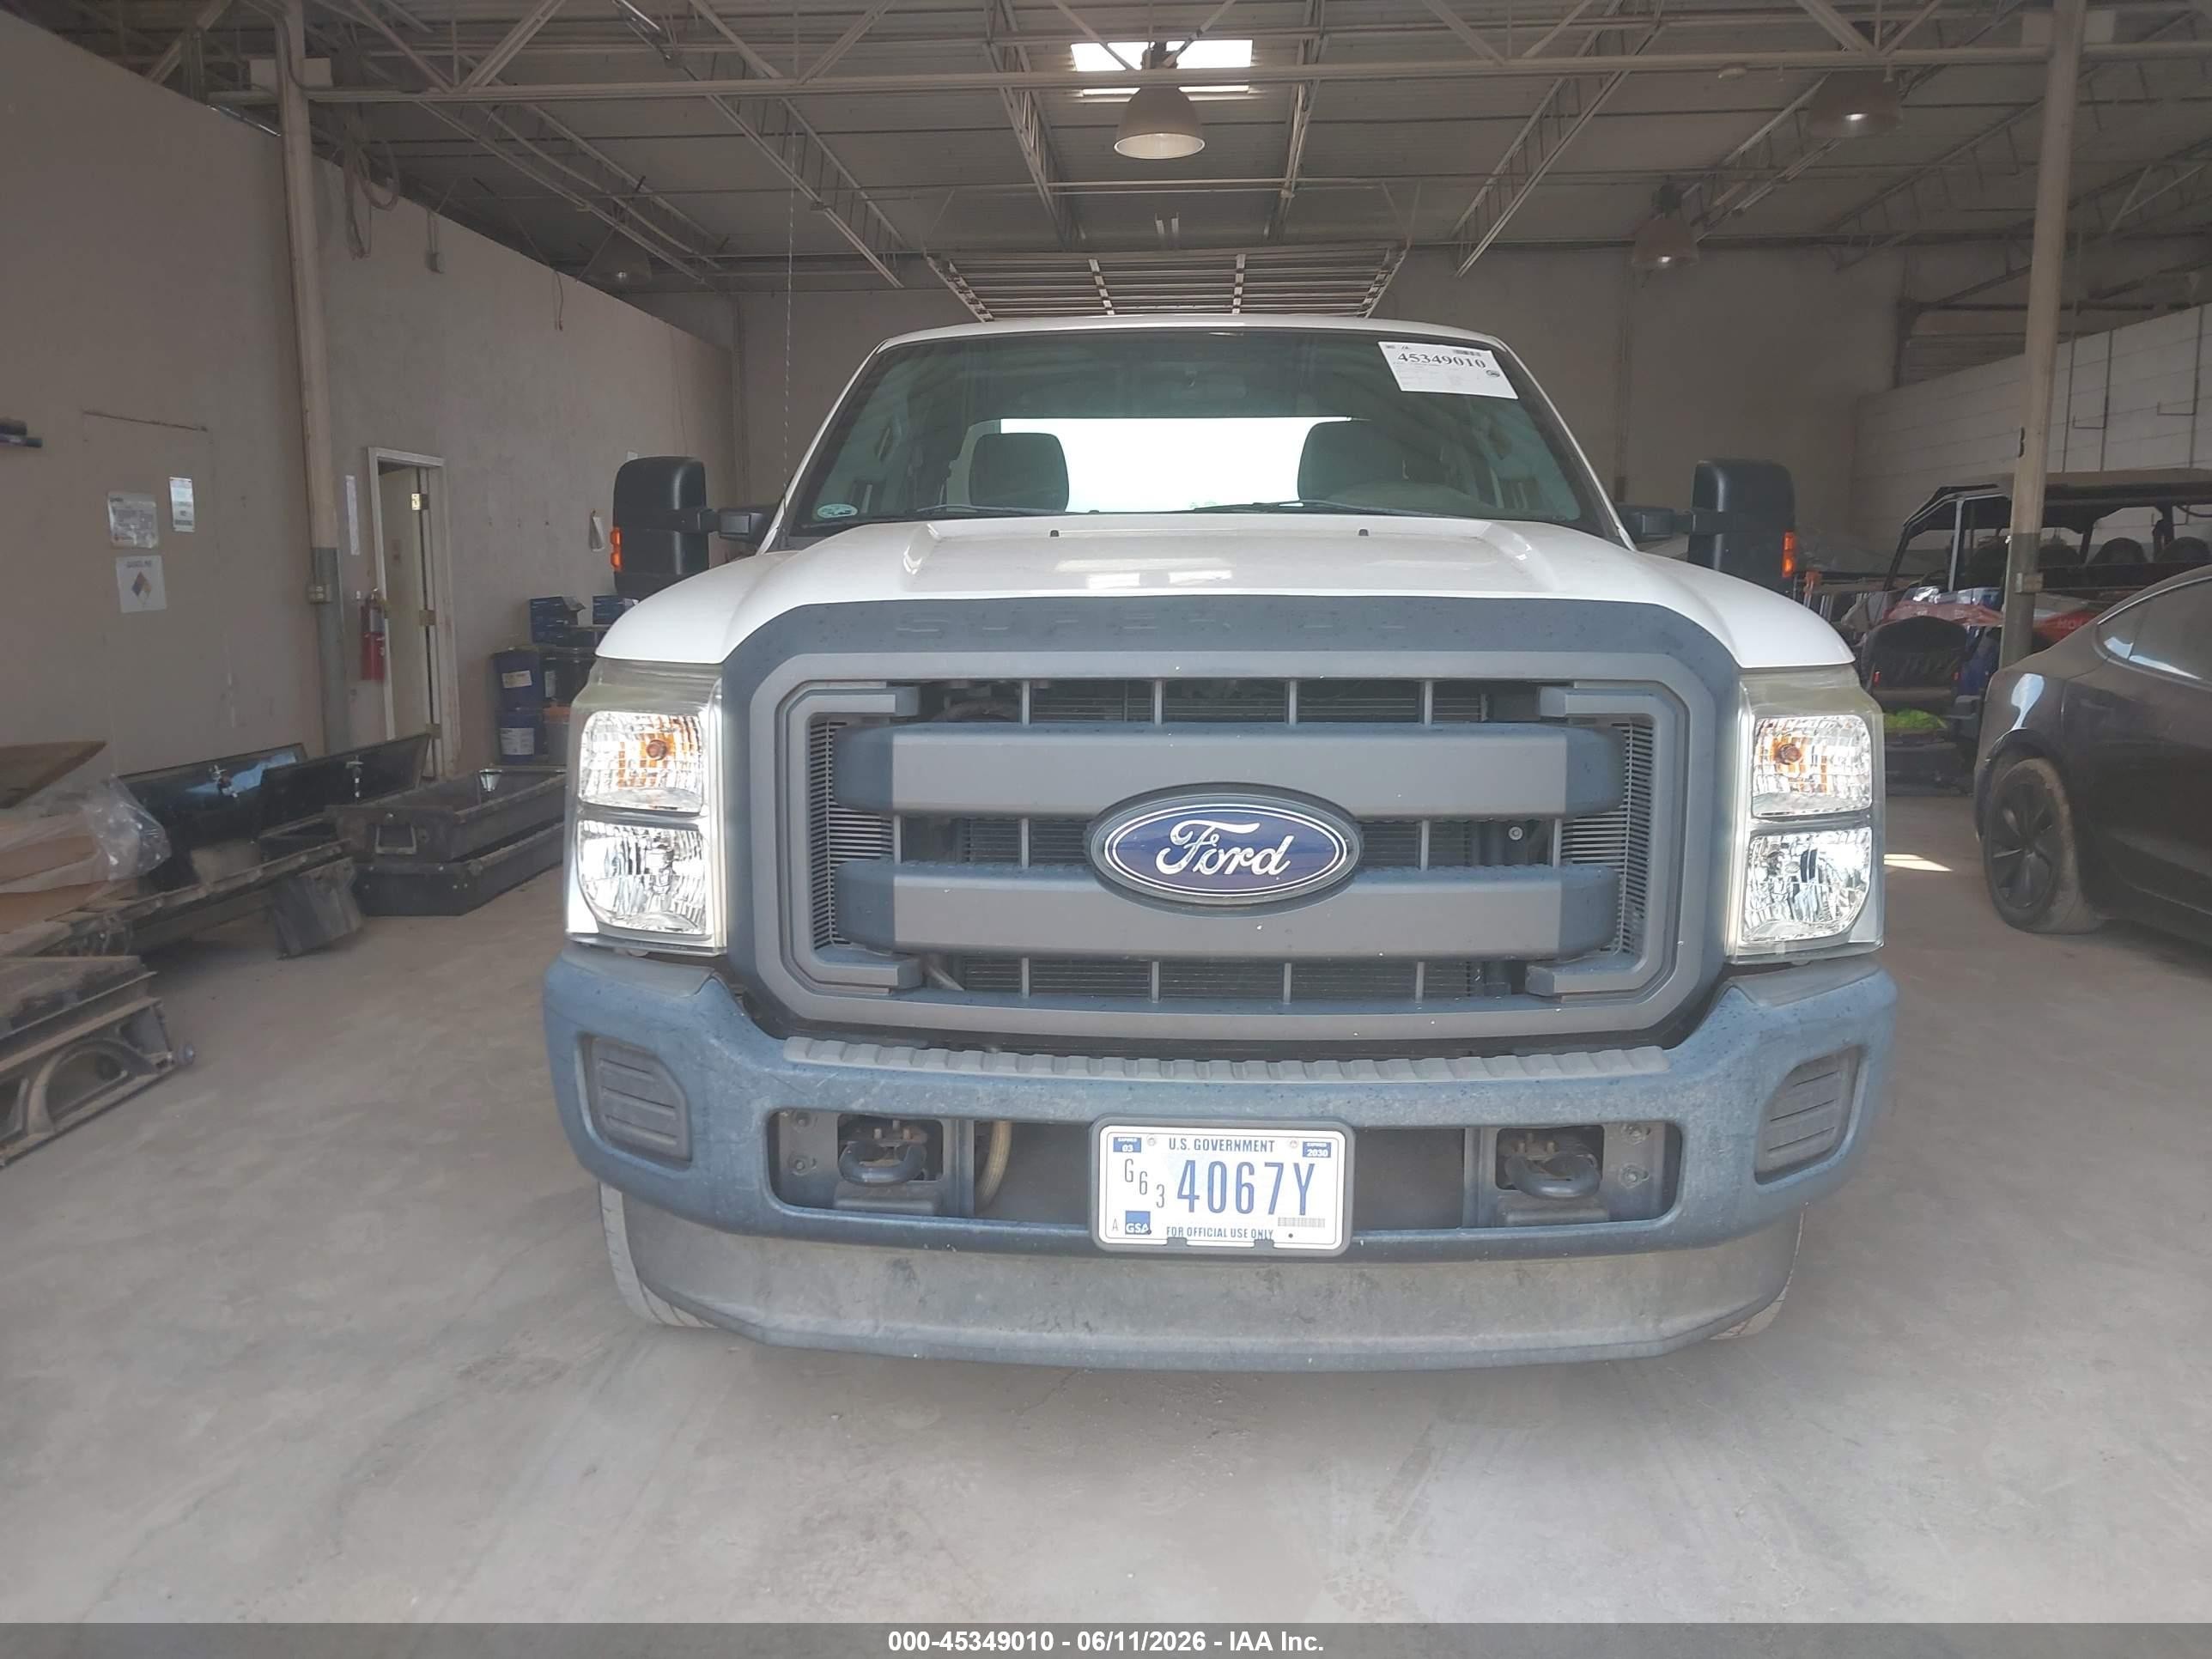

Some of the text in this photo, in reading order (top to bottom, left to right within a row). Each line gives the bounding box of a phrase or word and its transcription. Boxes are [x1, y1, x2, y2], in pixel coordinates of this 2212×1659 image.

[1398, 353, 1487, 369] 45349010
[1155, 819, 1295, 876] Ford
[1121, 1143, 1134, 1152] 03
[1169, 1138, 1275, 1153] U.S. GOVERNMENT
[1306, 1148, 1328, 1158] 2030
[1176, 1159, 1316, 1217] 4067Y
[1125, 1222, 1149, 1234] GSA
[1166, 1226, 1273, 1241] FOR OFFICIAL USE ONLY
